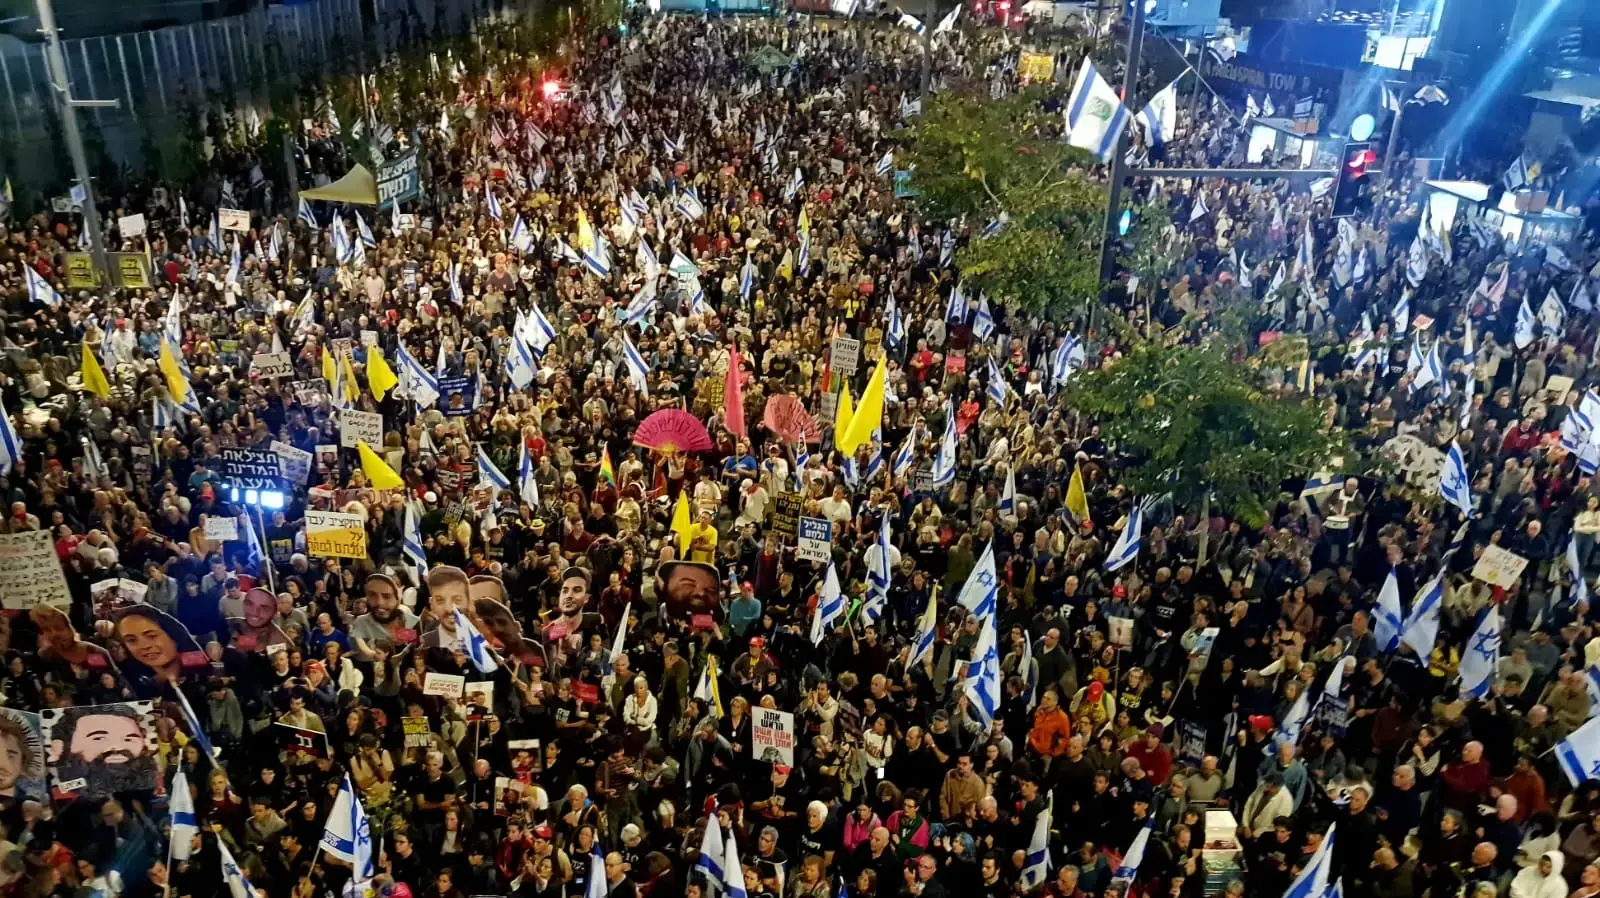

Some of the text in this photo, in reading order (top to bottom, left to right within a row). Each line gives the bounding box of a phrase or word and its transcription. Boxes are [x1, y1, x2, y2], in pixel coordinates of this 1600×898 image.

[1267, 72, 1312, 92] TOWR
[227, 463, 279, 476] המדינה
[225, 475, 277, 489] מעצמך
[803, 519, 828, 532] הגליל
[350, 530, 363, 541] על
[809, 540, 820, 549] על
[801, 547, 828, 560] ישראל
[763, 710, 781, 720] אתה
[761, 719, 784, 731] הראש
